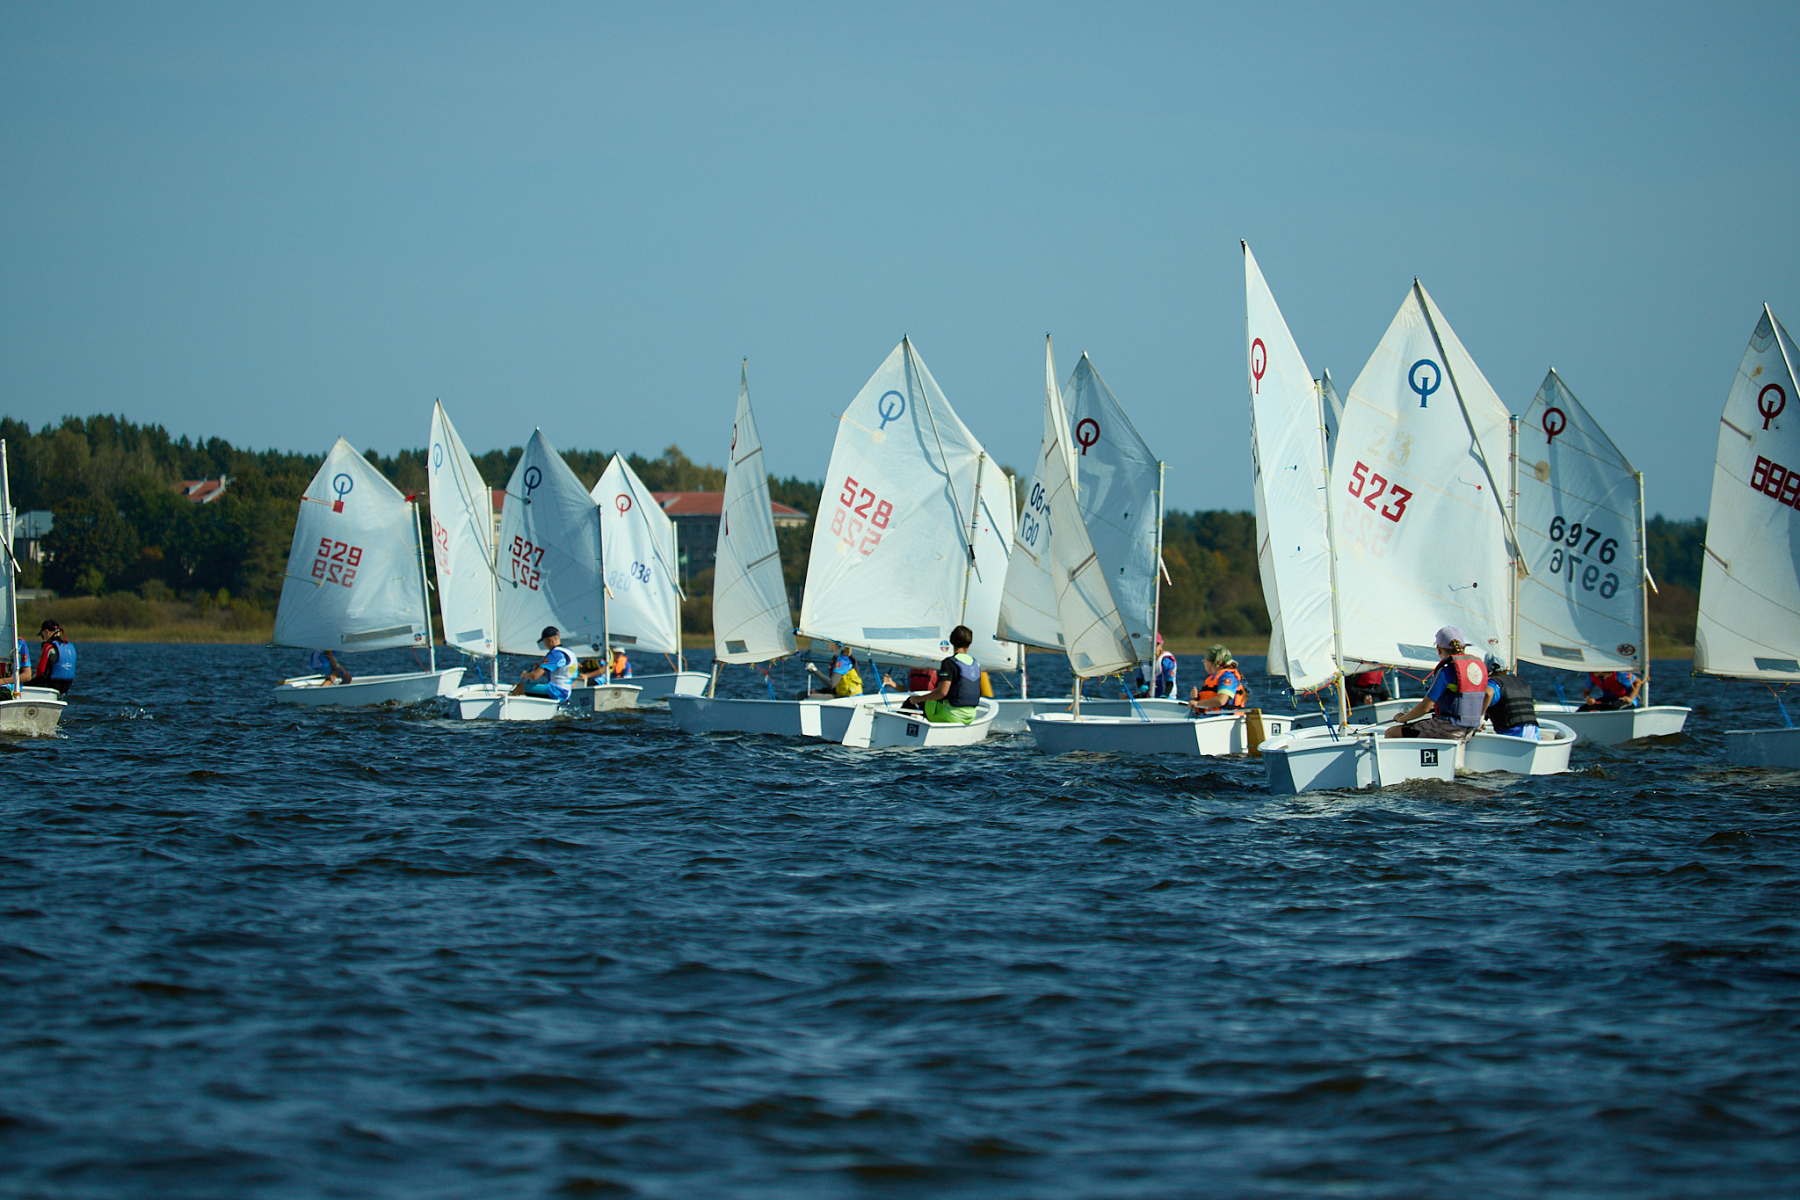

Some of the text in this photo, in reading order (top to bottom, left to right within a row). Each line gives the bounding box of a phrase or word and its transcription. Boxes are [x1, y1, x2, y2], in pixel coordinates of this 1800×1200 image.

[840, 476, 893, 530] 528
[1348, 460, 1413, 523] 523
[318, 537, 363, 567] 529
[513, 535, 545, 567] 527
[1549, 516, 1619, 565] 6976
[631, 561, 651, 583] 038
[1423, 750, 1436, 763] Pt
